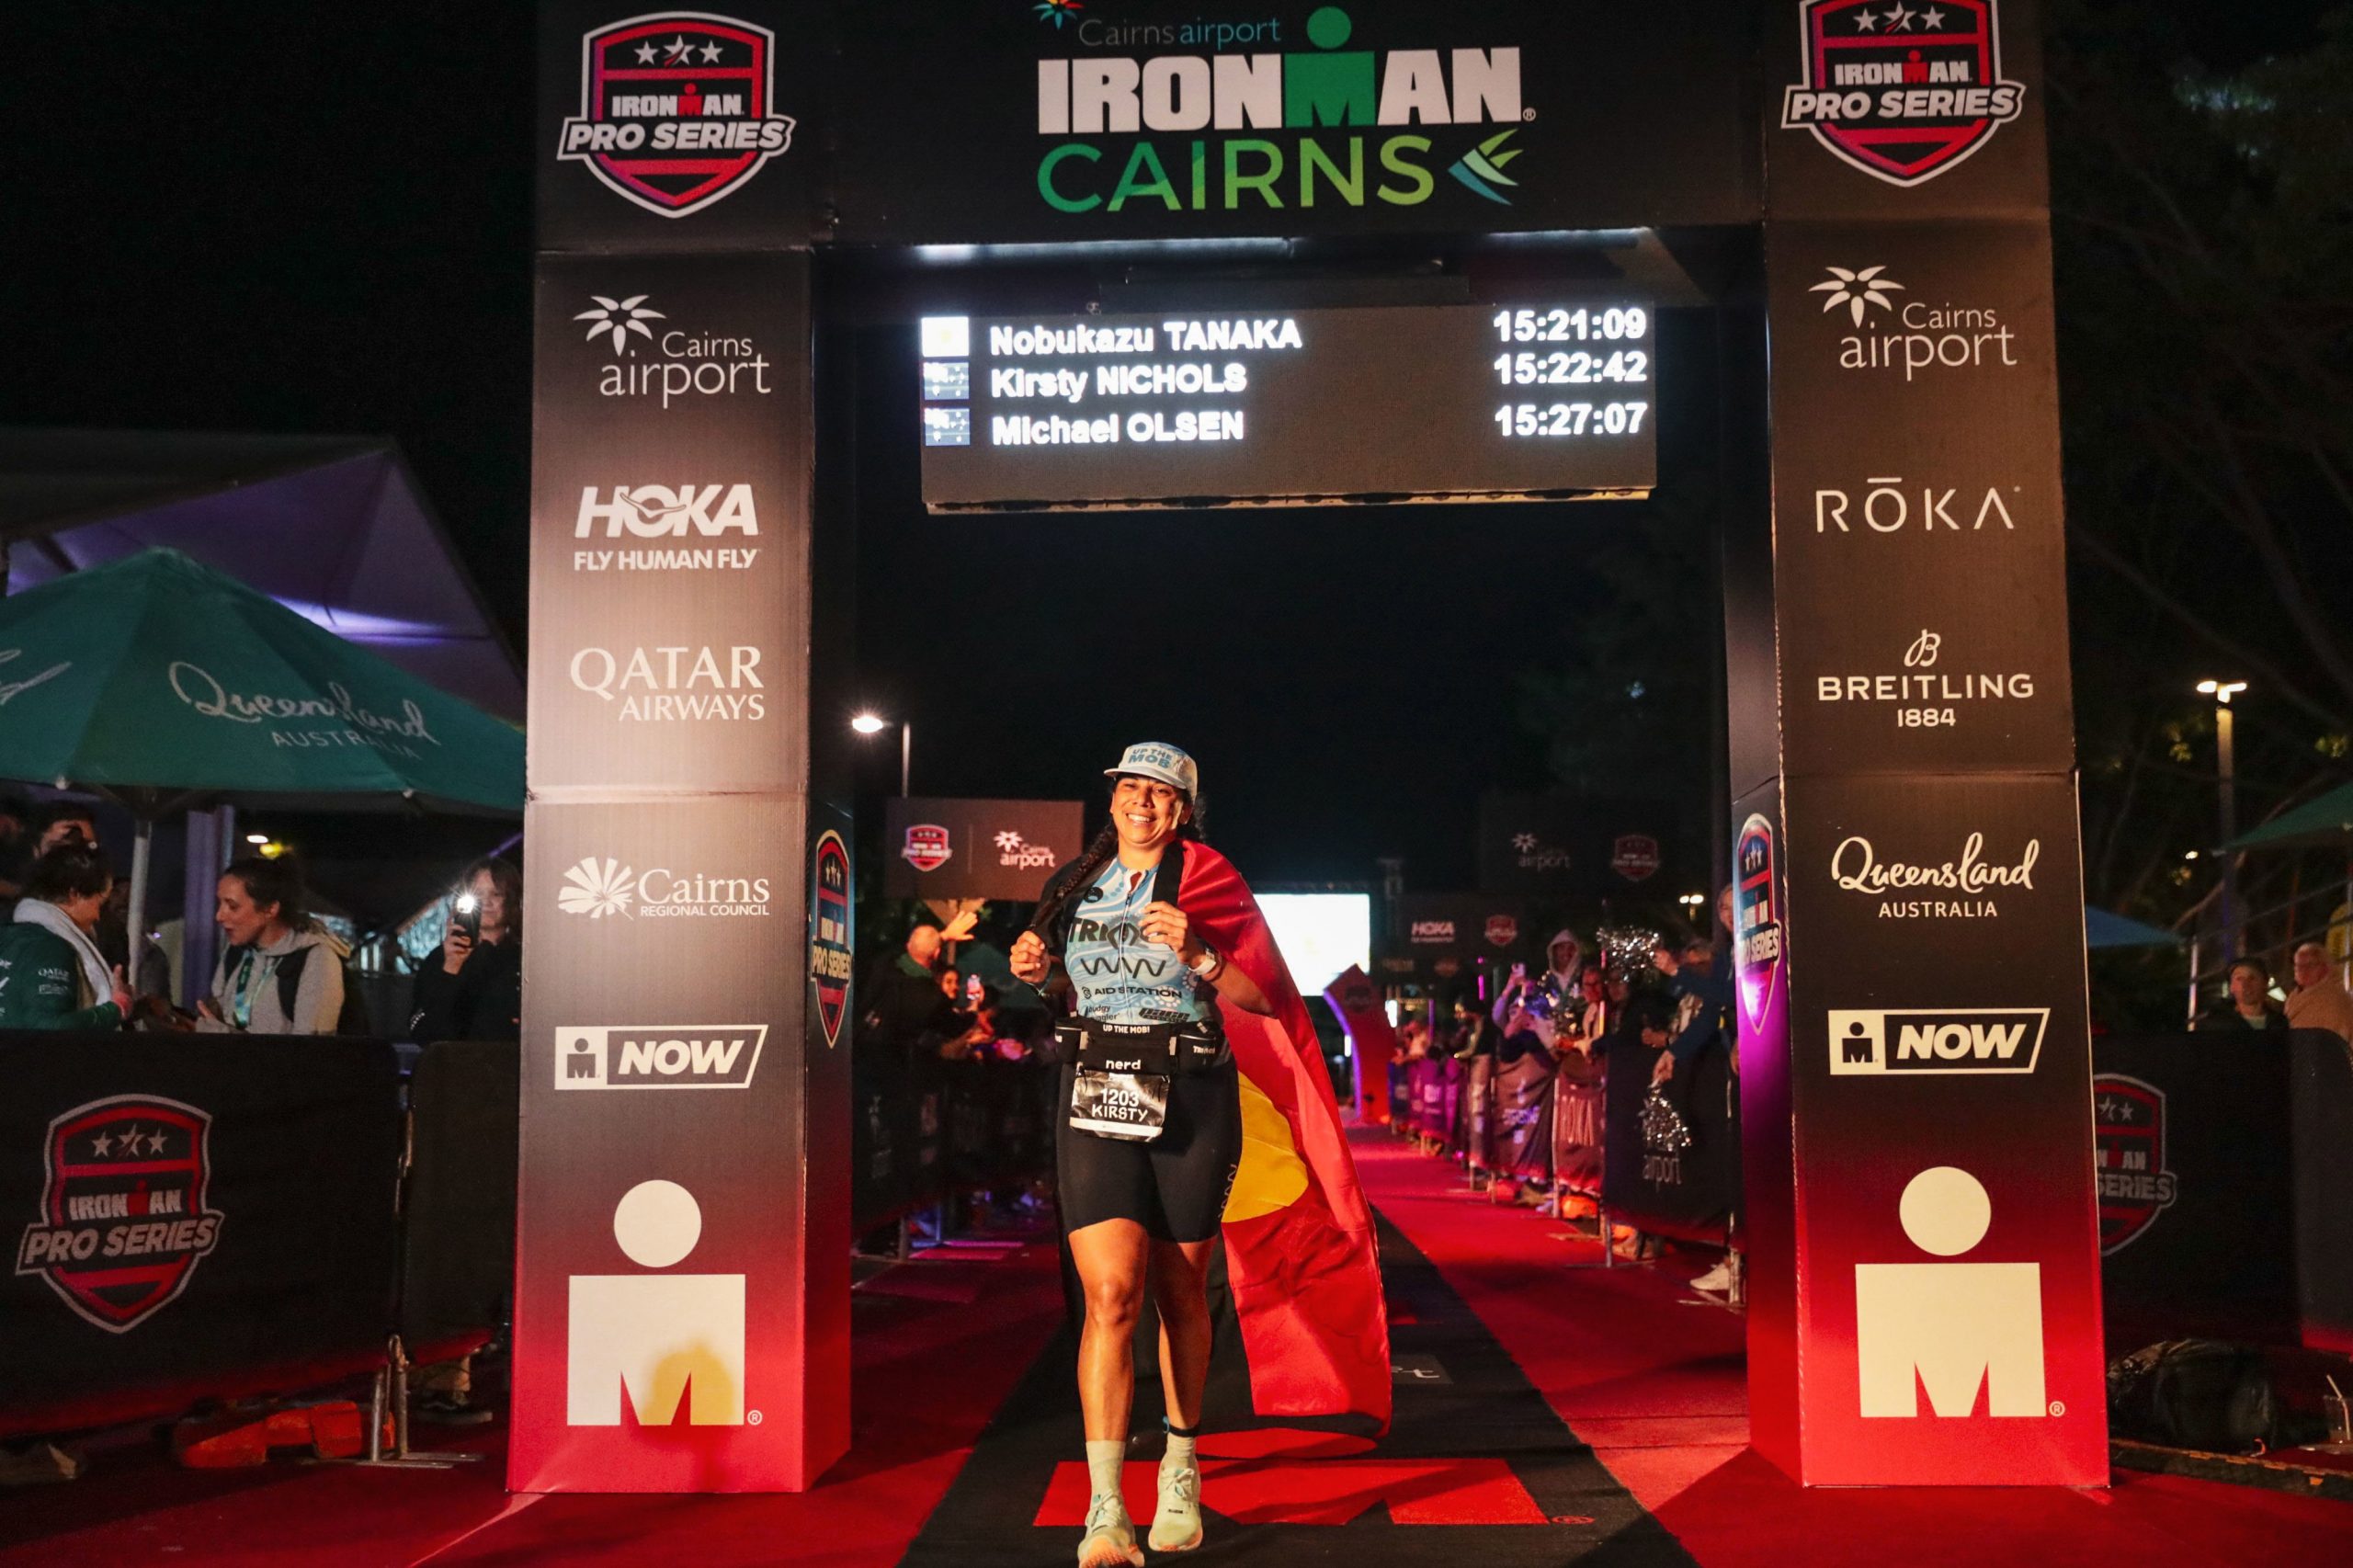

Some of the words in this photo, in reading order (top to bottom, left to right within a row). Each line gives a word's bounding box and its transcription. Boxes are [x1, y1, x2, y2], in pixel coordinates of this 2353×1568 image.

[1078, 18, 1175, 47] Cairns
[1179, 17, 1282, 51] airport
[1834, 60, 1971, 86] IRONMAN
[611, 94, 743, 118] IRONMAN
[1038, 47, 1522, 134] IRONMAN
[1791, 91, 1872, 120] PRO
[1878, 88, 2016, 119] SERIES
[566, 122, 646, 151] PRO
[651, 120, 786, 150] SERIES
[1037, 135, 1435, 213] CAIRNS
[1902, 301, 1997, 330] Cairns
[662, 331, 753, 358] Cairns
[990, 324, 1154, 356] Nobukazu
[1163, 319, 1303, 351] TANAKA
[1493, 308, 1648, 342] 15:21:09
[1839, 322, 2018, 382] airport
[599, 349, 772, 410] airport
[991, 369, 1088, 403] Kirsty
[1097, 362, 1248, 396] NICHOLS
[1493, 350, 1648, 385] 15:22:42
[992, 414, 1120, 446] Michael
[1127, 411, 1245, 442] OLSEN
[1494, 402, 1648, 437] 15:27:07
[574, 483, 759, 539] HOKA
[574, 550, 614, 571] FLY
[618, 549, 713, 571] HUMAN
[718, 548, 758, 569] FLY
[570, 646, 765, 701] QATAR
[1817, 674, 2035, 701] BREITLING
[168, 661, 441, 746] Queensland
[618, 693, 766, 722] AIRWAYS
[1897, 708, 1957, 728] 1884
[272, 730, 423, 761] AUSTRALIA
[1151, 749, 1173, 761] THE
[1128, 755, 1172, 769] MOB
[1000, 852, 1056, 870] airport
[1831, 832, 2040, 894] Queensland
[638, 869, 770, 904] Cairns
[641, 905, 707, 917] REGIONAL
[710, 903, 770, 916] COUNCIL
[1878, 901, 1998, 918] AUSTRALIA
[1095, 987, 1116, 995] AID
[1118, 986, 1183, 999] STATION
[1103, 1024, 1113, 1033] UP
[1114, 1025, 1129, 1034] THE
[1896, 1023, 2027, 1060] NOW
[618, 1040, 745, 1075] NOW
[1105, 1059, 1142, 1070] nerd
[1091, 1104, 1149, 1122] KIRSTY
[1102, 1088, 1140, 1108] 1203
[24, 1229, 99, 1265] PRO
[101, 1217, 216, 1257] SERIES
